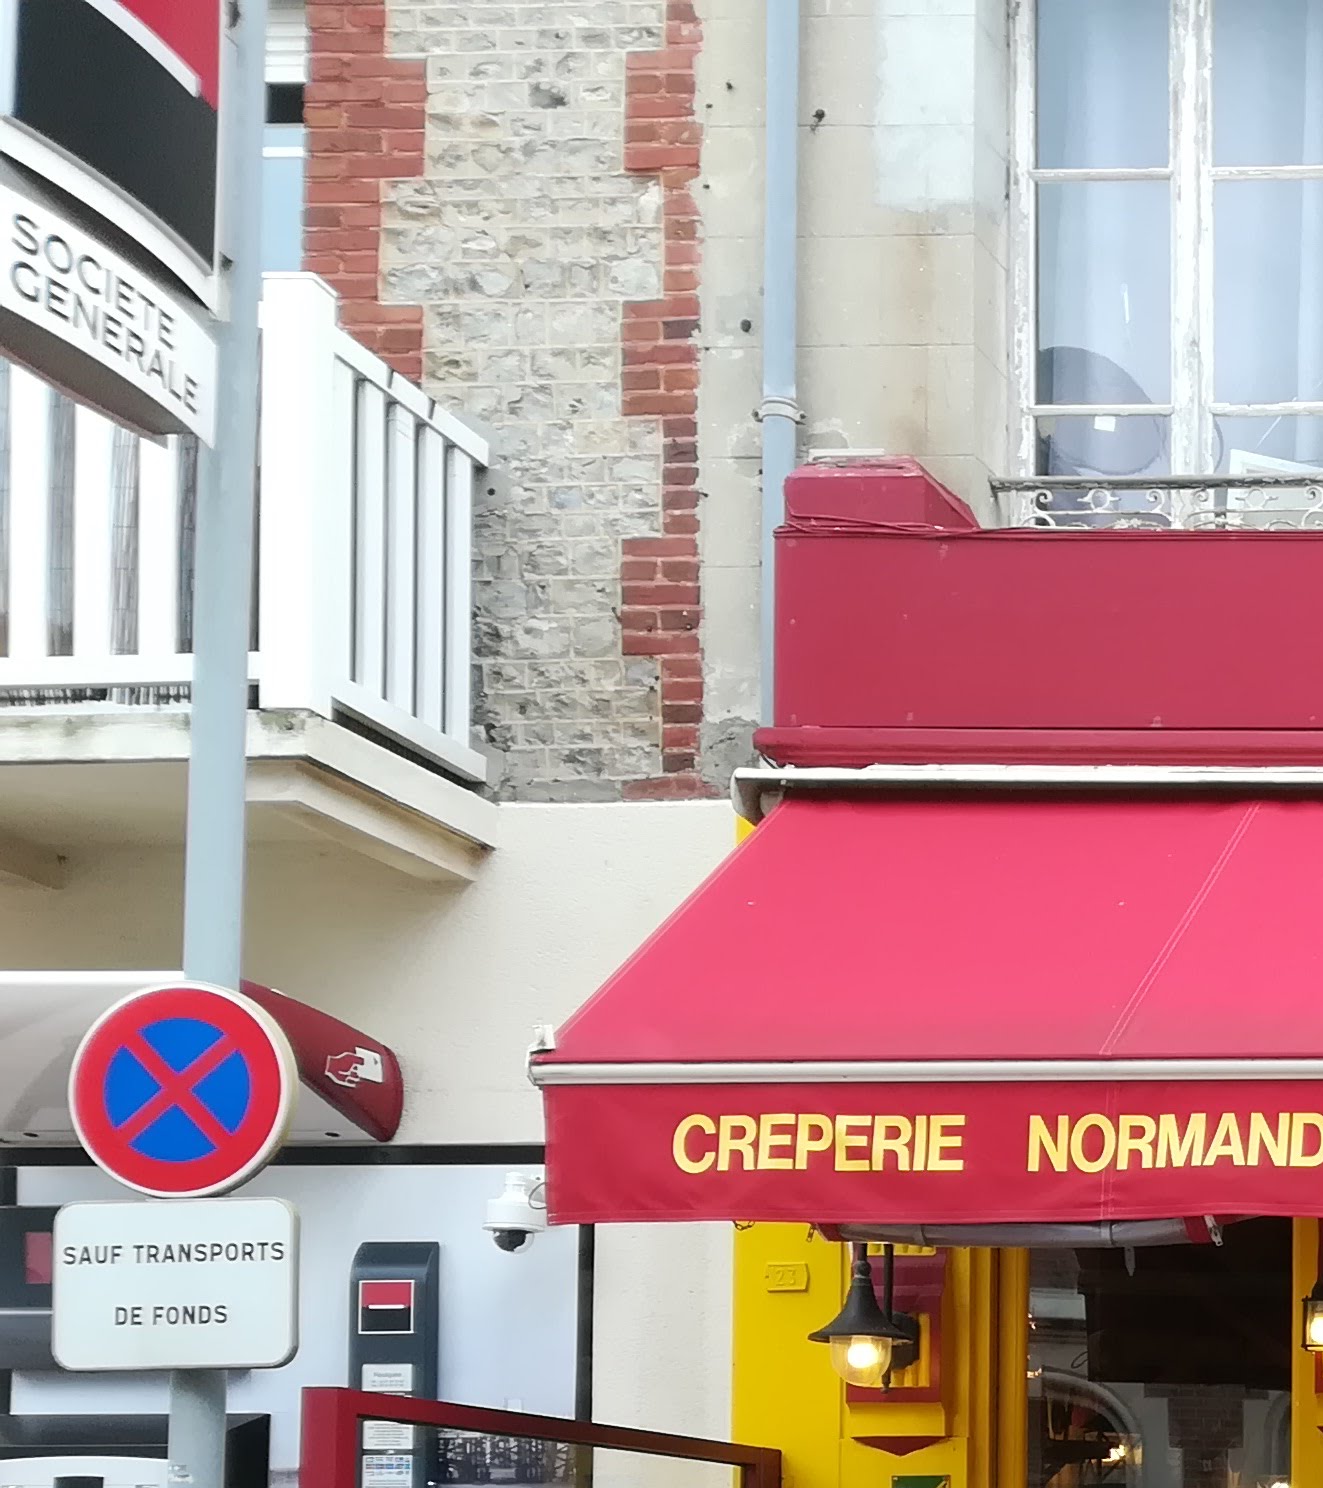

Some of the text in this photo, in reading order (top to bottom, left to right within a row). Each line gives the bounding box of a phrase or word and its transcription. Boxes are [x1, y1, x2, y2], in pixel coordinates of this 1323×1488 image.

[10, 212, 176, 352] SOCIETE
[8, 260, 200, 416] GENERALE
[672, 1113, 966, 1173] CREPERIE
[63, 1241, 285, 1266] SAUF TRANSPORTS
[115, 1305, 229, 1326] DE FONDS
